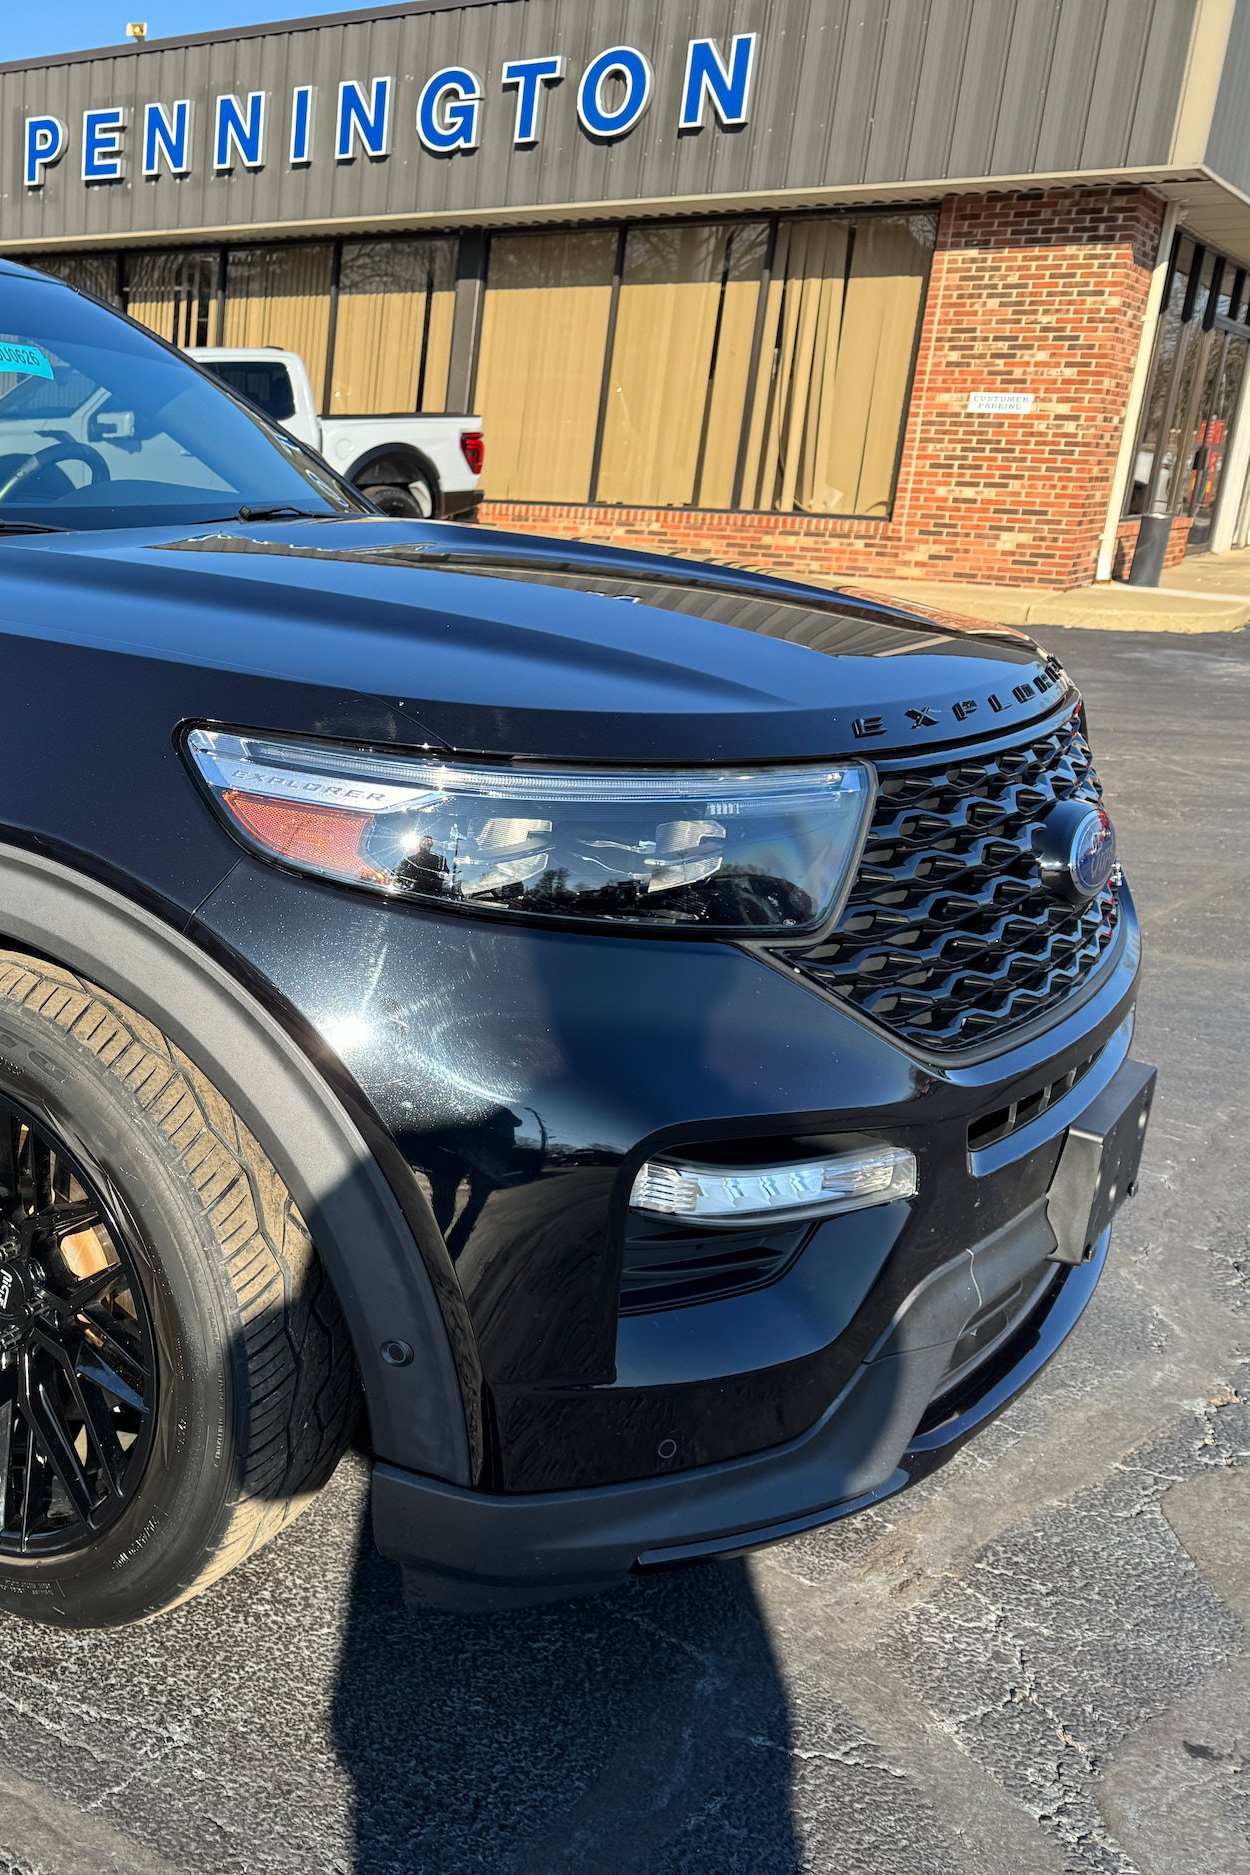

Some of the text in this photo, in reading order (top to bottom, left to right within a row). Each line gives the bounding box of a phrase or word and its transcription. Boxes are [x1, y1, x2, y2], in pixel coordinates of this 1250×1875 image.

[23, 32, 757, 187] PENNINGTON
[972, 394, 1030, 403] CUSTOMER
[977, 402, 1023, 410] PARKING
[231, 768, 387, 802] EXPLORER
